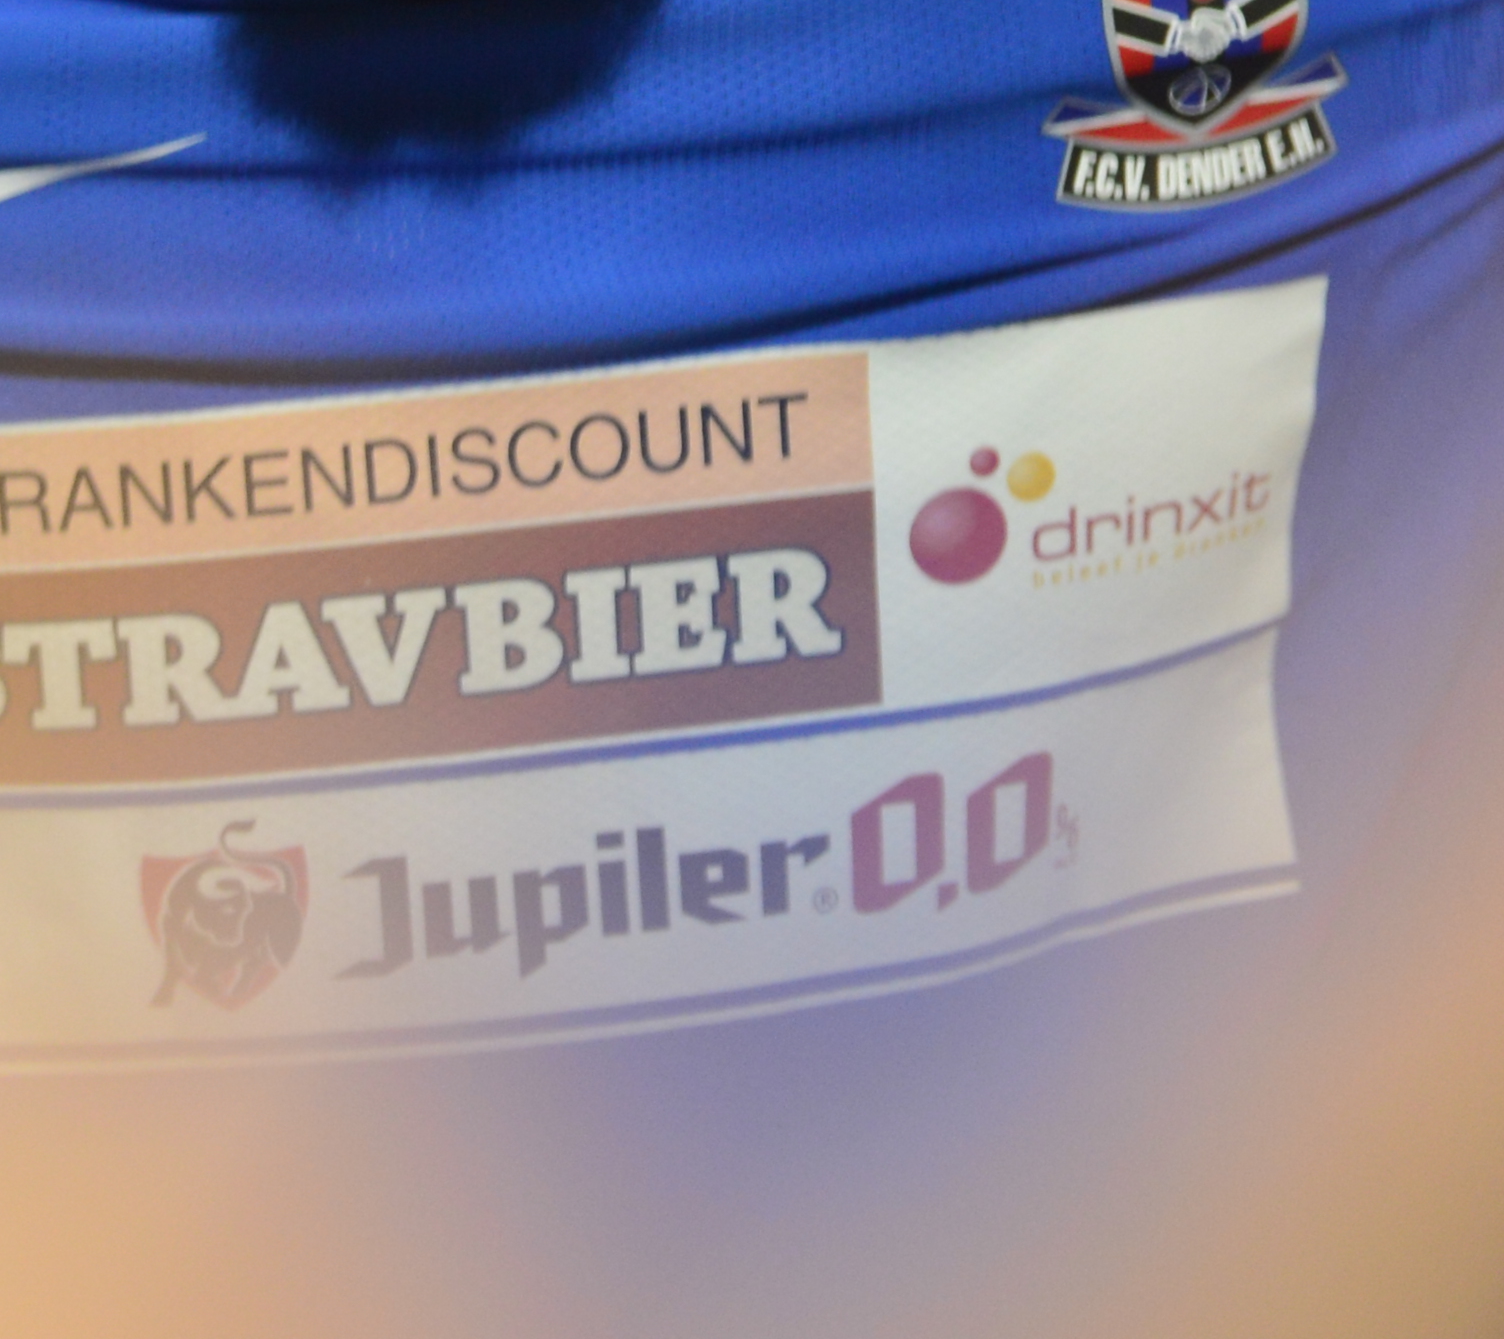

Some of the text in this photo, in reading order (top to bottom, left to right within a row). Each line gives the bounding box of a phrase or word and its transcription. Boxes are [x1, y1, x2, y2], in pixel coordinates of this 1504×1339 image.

[1073, 150, 1150, 201] F.C.V.
[1157, 139, 1267, 201] DENDER
[1032, 472, 1272, 562] drinxit
[333, 826, 830, 979] Jupiler
